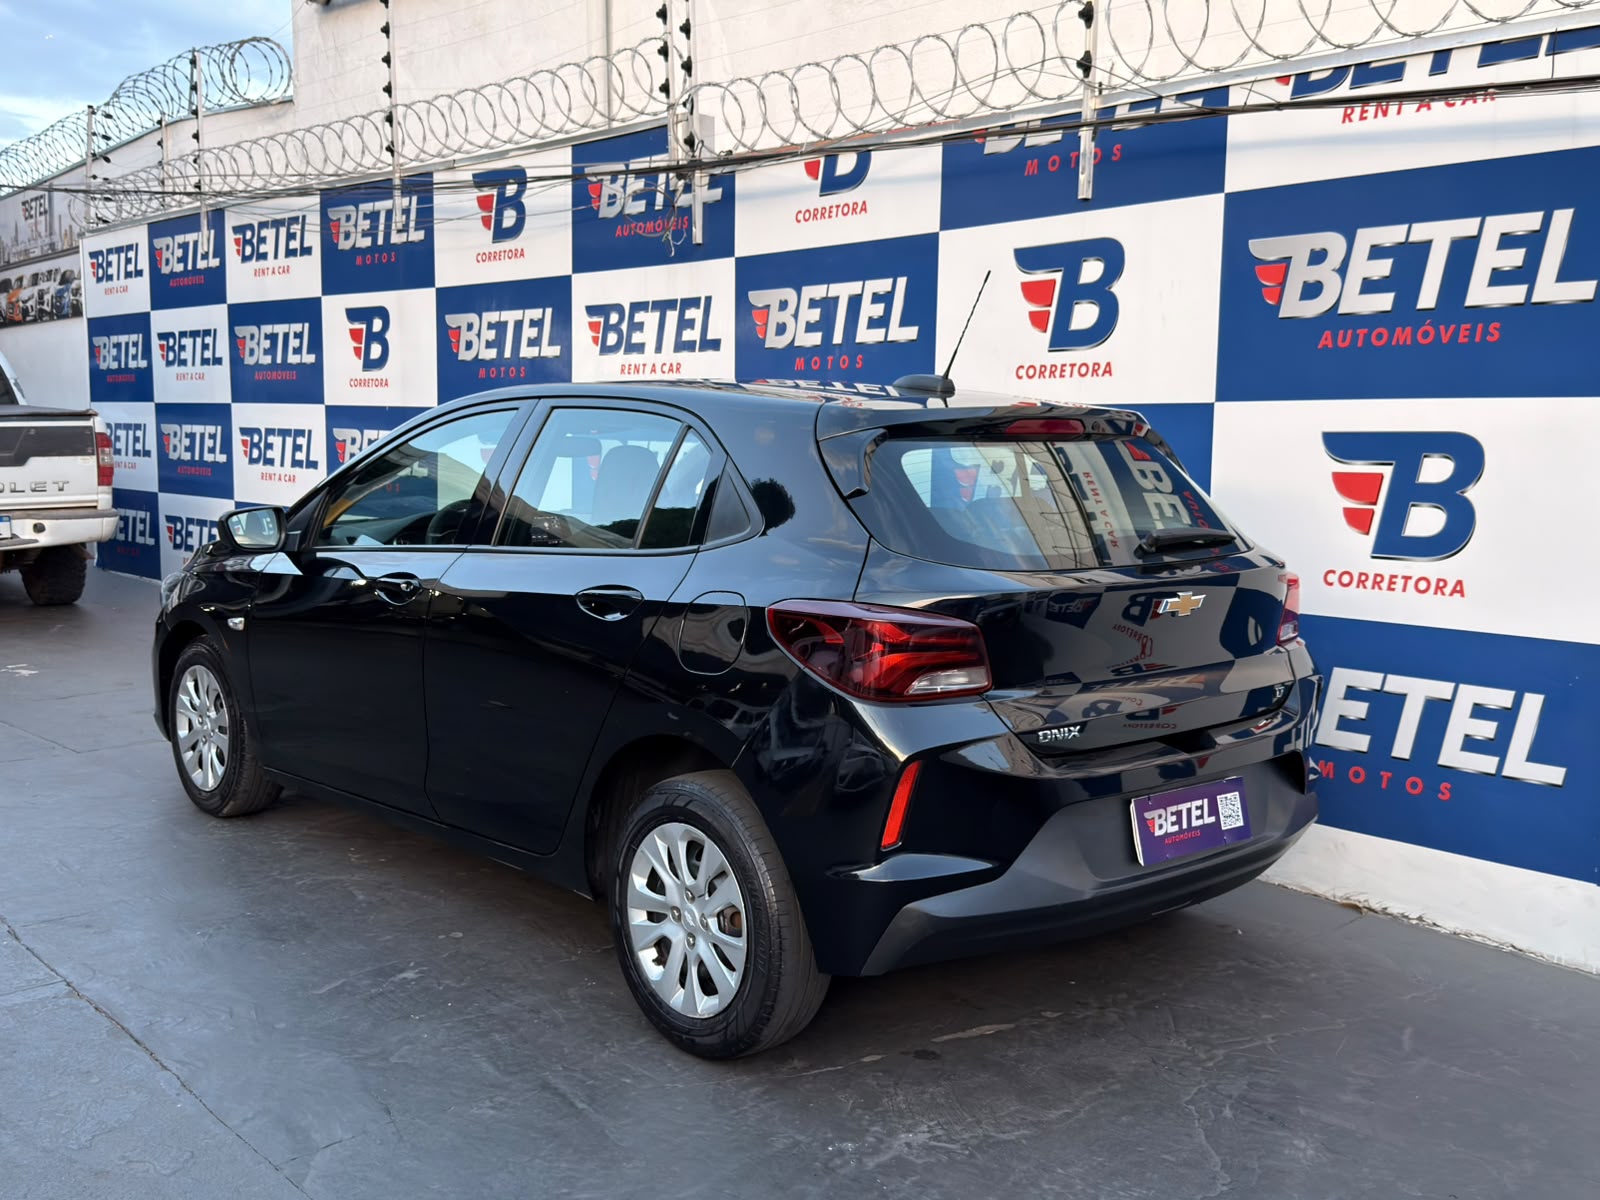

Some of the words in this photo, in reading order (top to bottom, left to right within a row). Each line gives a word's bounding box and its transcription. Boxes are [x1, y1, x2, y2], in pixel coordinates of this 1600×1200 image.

[21, 193, 48, 221] BETEL
[328, 195, 425, 250] BETEL
[795, 200, 868, 224] CORRETORA
[232, 214, 313, 264] BETEL
[88, 242, 144, 284] BETEL
[254, 267, 269, 277] RENT
[271, 266, 276, 276] A
[277, 265, 291, 275] CAR
[356, 251, 397, 265] MOTOS
[476, 248, 525, 264] CORRETORA
[1248, 208, 1599, 319] BETEL
[585, 296, 722, 356] BETEL
[748, 276, 919, 349] BETEL
[157, 328, 223, 367] BETEL
[234, 322, 316, 366] BETEL
[445, 307, 561, 361] BETEL
[1317, 320, 1501, 349] AUTOMÓVEIS
[92, 333, 148, 370] BETEL
[794, 354, 864, 371] MOTOS
[176, 373, 189, 381] RENT
[194, 372, 205, 380] CAR
[349, 378, 389, 388] CORRETORA
[479, 366, 526, 378] MOTOS
[620, 363, 646, 375] RENT
[650, 363, 657, 374] A
[660, 362, 681, 374] CAR
[1016, 361, 1113, 380] CORRETORA
[161, 424, 227, 463] BETEL
[239, 427, 319, 470] BETEL
[114, 461, 123, 469] ENT
[261, 472, 277, 483] RENT
[278, 473, 283, 482] A
[283, 474, 296, 483] CAR
[113, 508, 156, 545] ETEL
[1323, 569, 1466, 598] CORRETORA
[1037, 725, 1082, 743] ONIX
[1314, 666, 1567, 787] ETEL
[1317, 760, 1453, 801] MOTOS
[1143, 798, 1216, 837] BETEL
